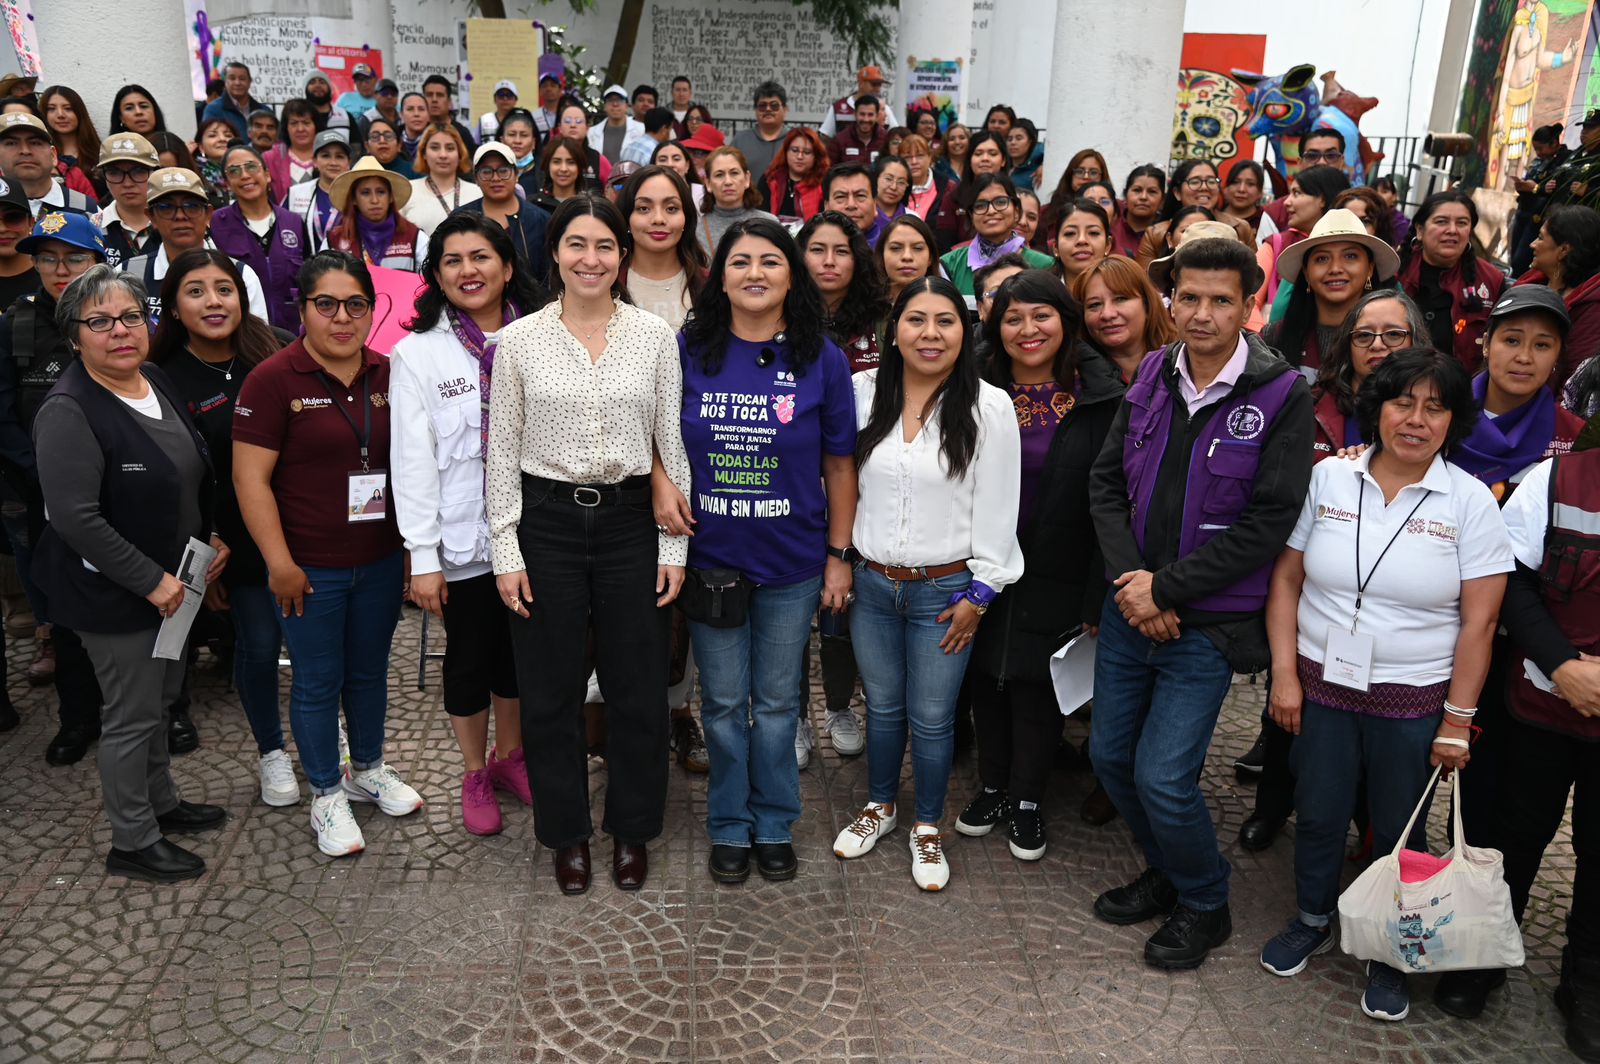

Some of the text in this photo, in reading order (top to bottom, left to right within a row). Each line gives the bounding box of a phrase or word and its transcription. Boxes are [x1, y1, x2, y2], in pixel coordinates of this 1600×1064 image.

[221, 25, 313, 40] catepec Momo
[241, 54, 306, 68] habitantes
[409, 61, 456, 75] Momoxc
[437, 377, 466, 392] SALUD
[440, 383, 477, 400] PÚBLICA
[302, 397, 333, 407] Mujeres
[702, 392, 768, 406] SI TE TOCAN
[700, 404, 769, 422] NOS TOCA
[710, 424, 777, 436] TRANSFORMARNOS
[713, 433, 739, 442] JUNTOS
[747, 435, 772, 444] JUNTAS
[725, 443, 759, 452] PARA QUE
[707, 452, 779, 469] TODAS LAS
[714, 469, 770, 486] MUJERES
[699, 493, 790, 518] VIVAN SIN MIEDO
[1326, 506, 1360, 520] Mujeres
[1428, 523, 1458, 536] LIBRE
[1435, 532, 1456, 541] Mujeres
